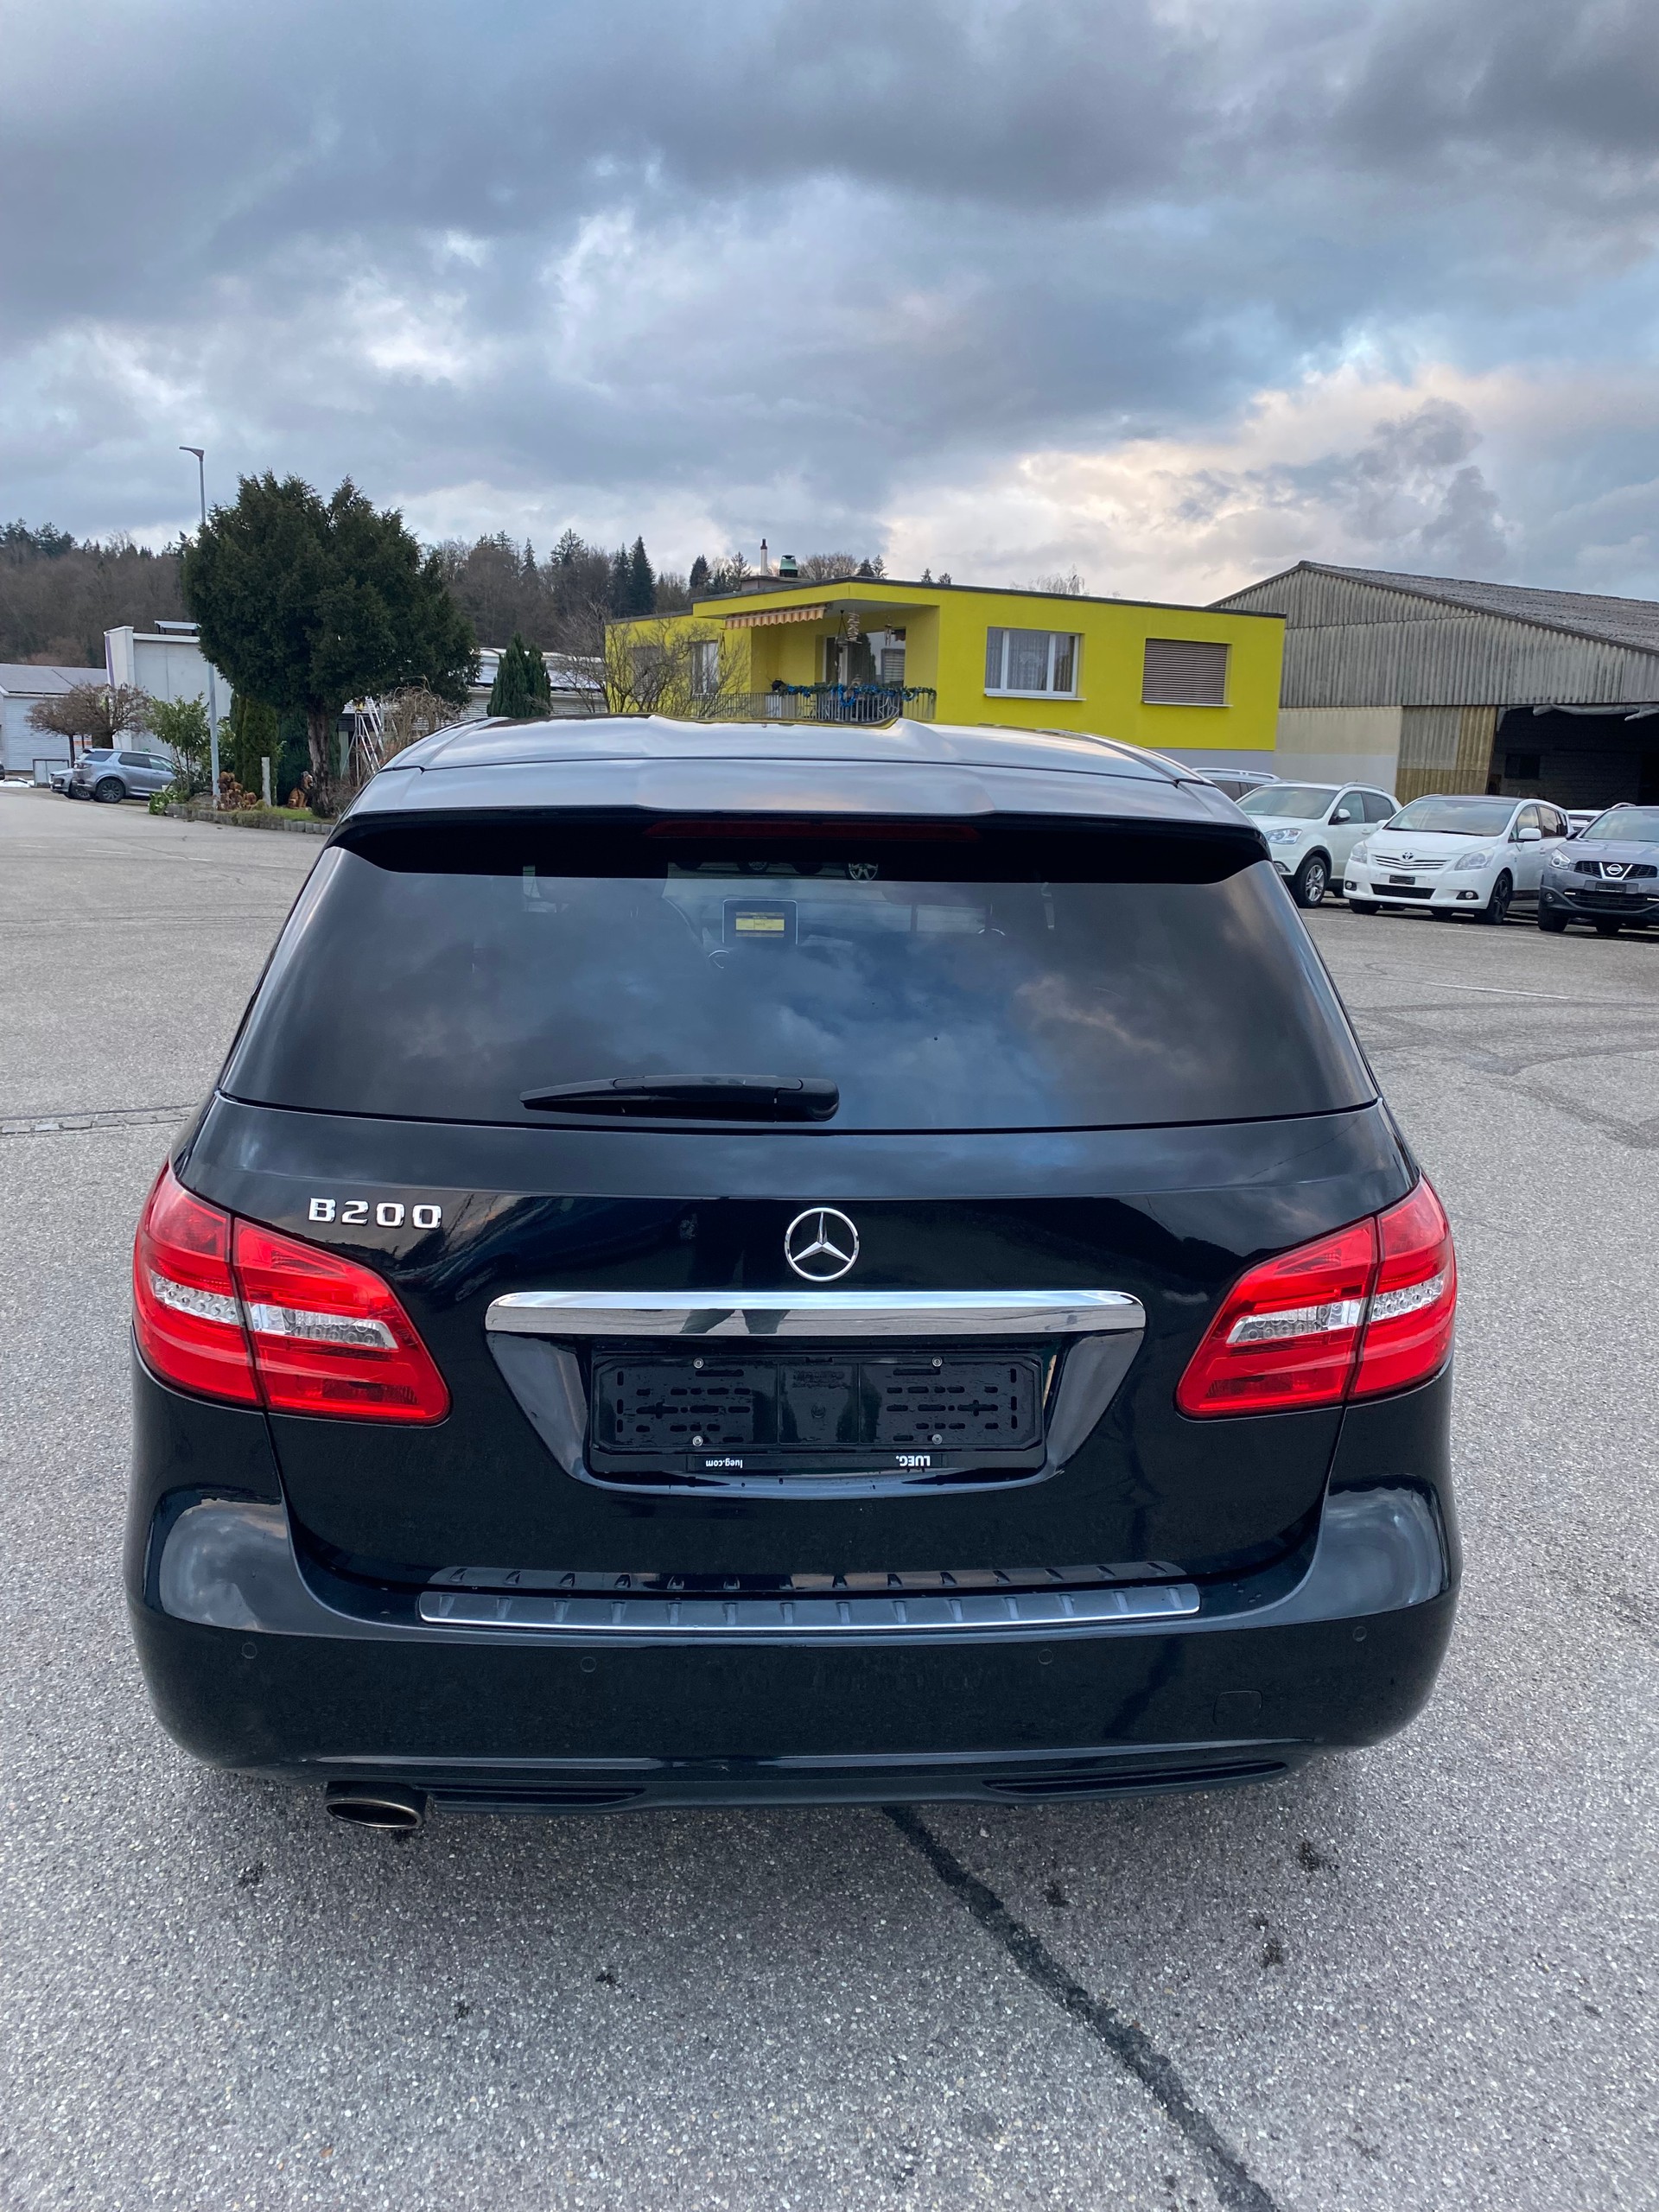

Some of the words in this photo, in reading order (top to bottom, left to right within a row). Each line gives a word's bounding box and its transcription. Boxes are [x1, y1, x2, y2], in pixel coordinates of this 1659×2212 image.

[308, 1198, 442, 1230] B200
[705, 1457, 743, 1469] lueg.com
[895, 1455, 931, 1467] LUEG.
